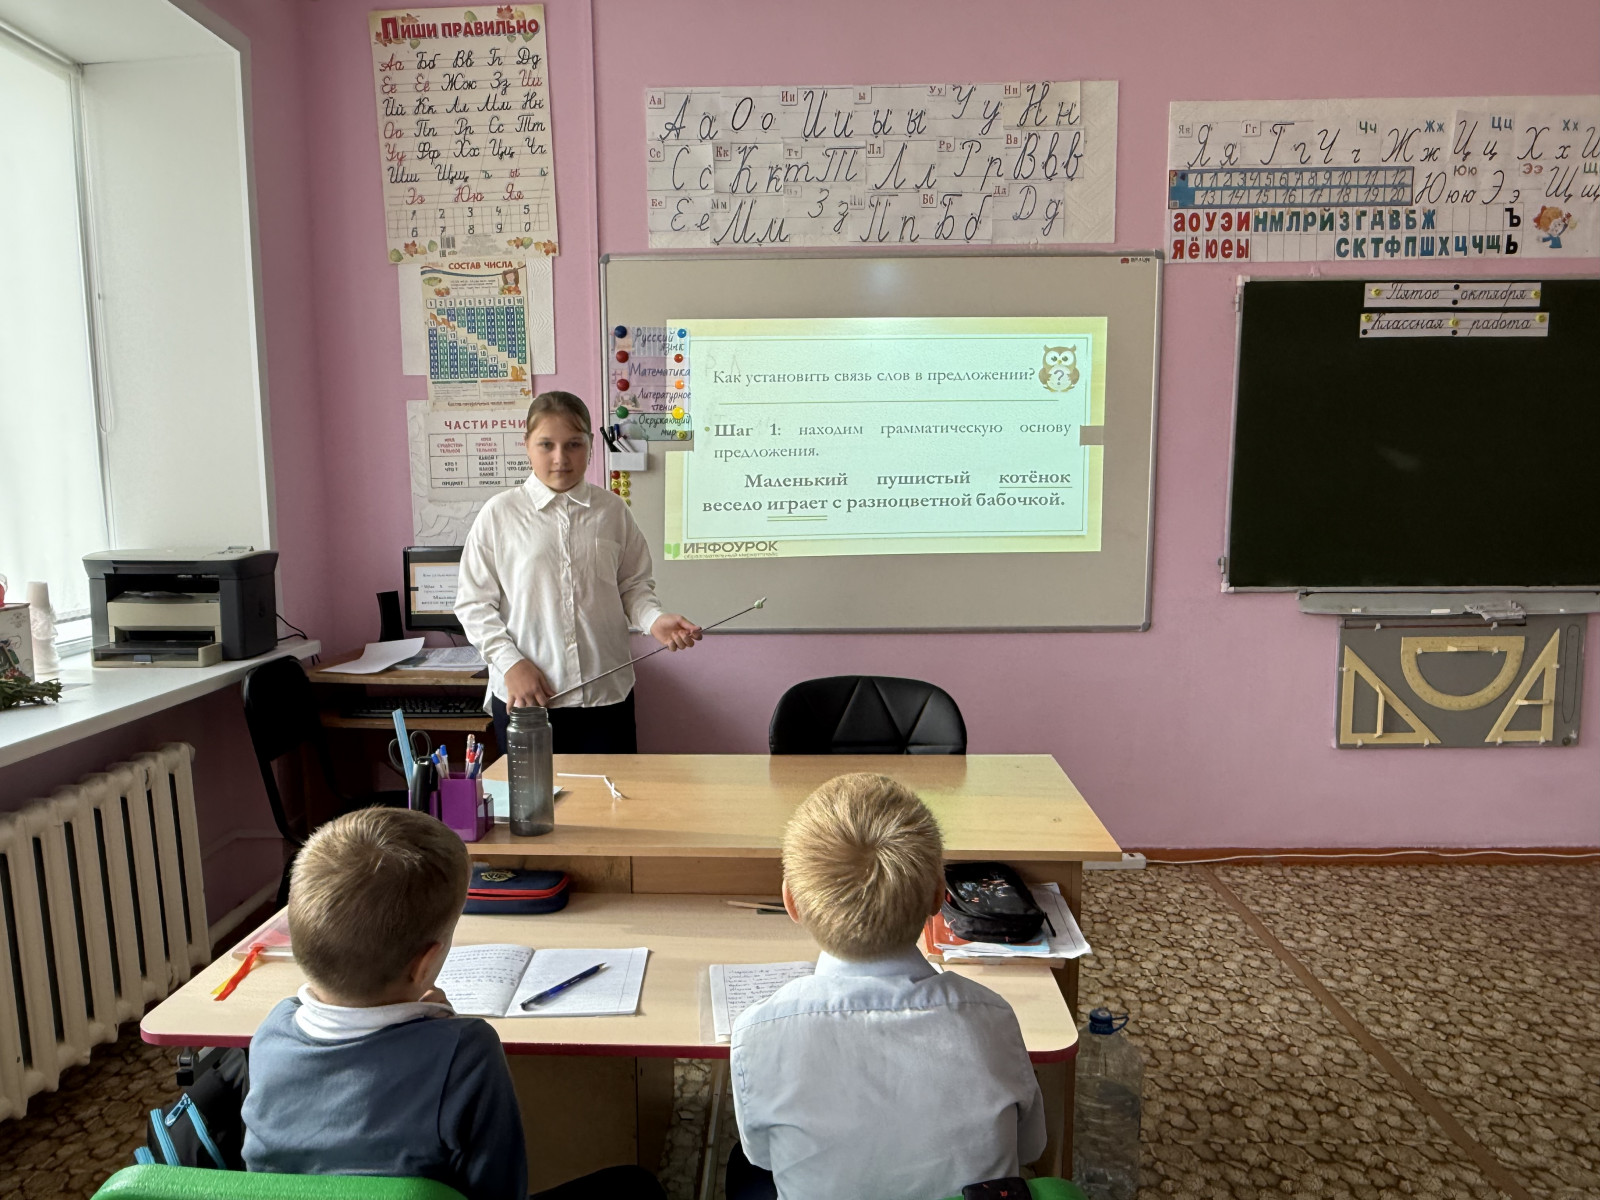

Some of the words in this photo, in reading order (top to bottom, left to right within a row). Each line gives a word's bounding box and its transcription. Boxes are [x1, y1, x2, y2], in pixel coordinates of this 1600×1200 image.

[441, 19, 539, 38] ПРАВИЛЬНО
[448, 262, 481, 270] СОСТАВ
[484, 261, 513, 269] ЧИСЛА
[1386, 282, 1440, 299] Пятое
[1461, 282, 1527, 307] октября
[1371, 312, 1444, 330] Классная
[1468, 312, 1532, 336] работа
[632, 327, 675, 348] Русский
[628, 362, 691, 377] Математика
[713, 370, 741, 383] Как
[746, 373, 830, 387] установить
[834, 372, 872, 382] связь
[877, 372, 910, 381] слов
[915, 372, 922, 381] в
[928, 368, 1035, 384] предложении?
[637, 387, 692, 404] Литературное
[444, 420, 488, 430] ЧАСТИ
[491, 419, 527, 429] РЕЧИ
[714, 424, 753, 437] Шаг
[770, 423, 781, 436] 1:
[799, 426, 863, 436] находим
[880, 423, 1003, 438] грамматическую
[1020, 422, 1072, 437] основу
[661, 429, 677, 440] мир
[714, 448, 819, 462] предложения.
[744, 472, 848, 488] Маленький
[877, 471, 970, 489] пушистый
[999, 470, 1071, 484] котёнок
[702, 500, 763, 512] весело
[767, 499, 828, 514] играет
[832, 499, 842, 509] с
[847, 493, 972, 513] разноцветной
[976, 492, 1065, 507] бабочкой.
[684, 541, 778, 554] ИНФОУРОК
